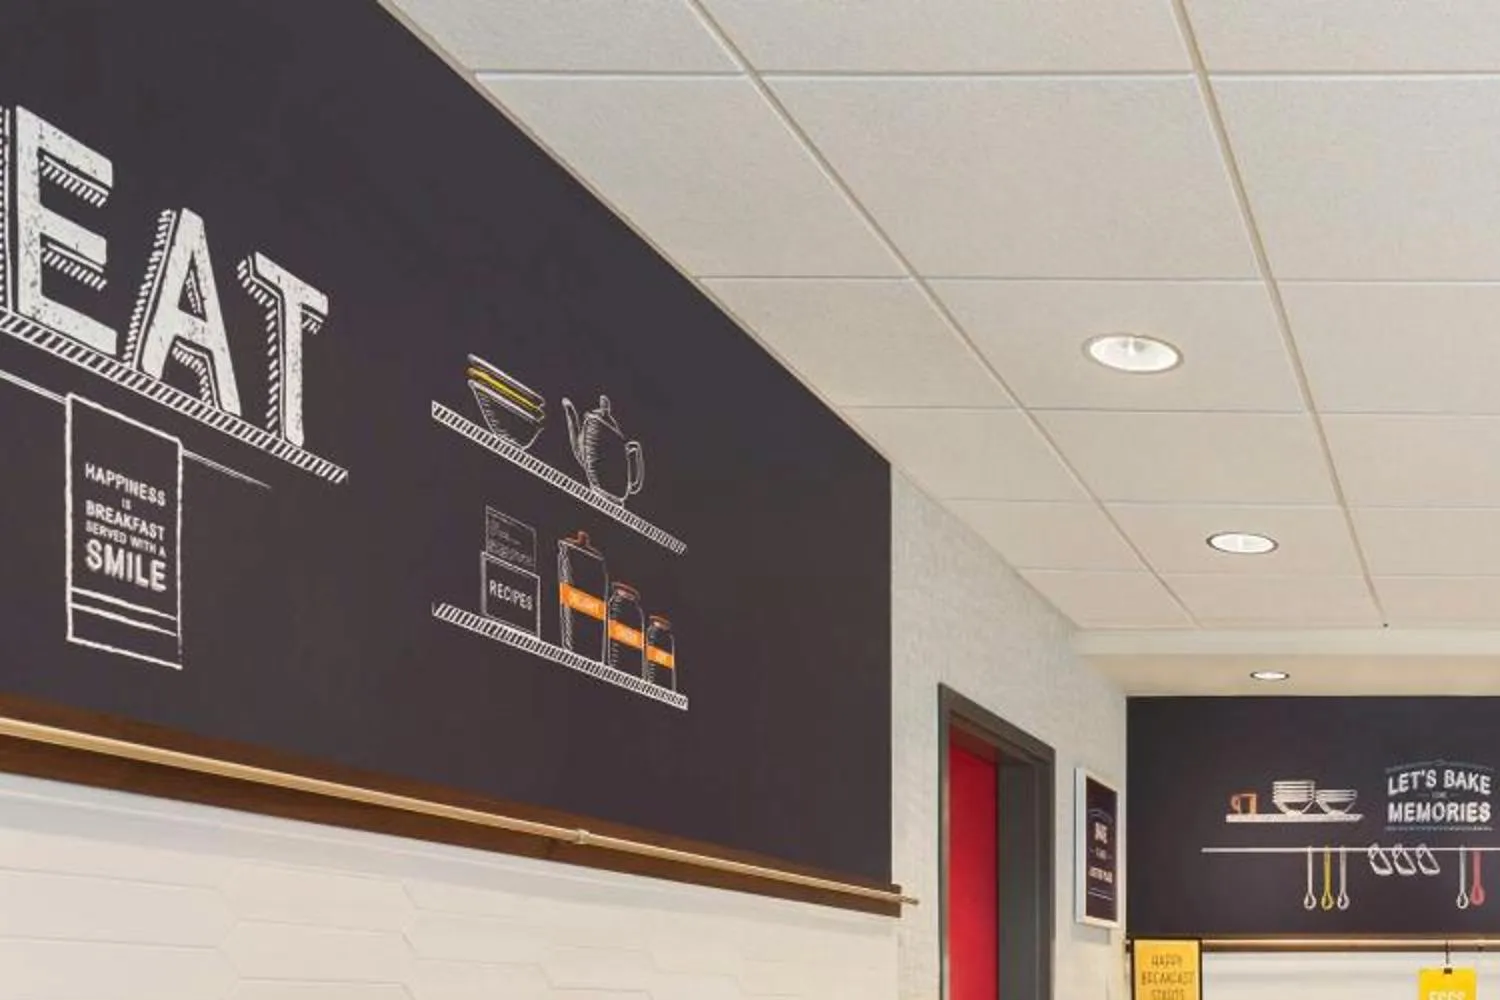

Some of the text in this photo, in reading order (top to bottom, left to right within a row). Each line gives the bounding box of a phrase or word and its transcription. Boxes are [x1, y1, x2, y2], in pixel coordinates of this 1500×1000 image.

[3, 104, 330, 448] EAT
[84, 463, 166, 507] HAPPINESS
[85, 499, 165, 540] BREAKFAST
[85, 520, 167, 557] SERVED WITH A
[85, 538, 167, 592] SMILE
[489, 578, 533, 611] RECIPES
[1388, 769, 1492, 796] LET'S BAKE
[1388, 801, 1492, 823] MEMORIES
